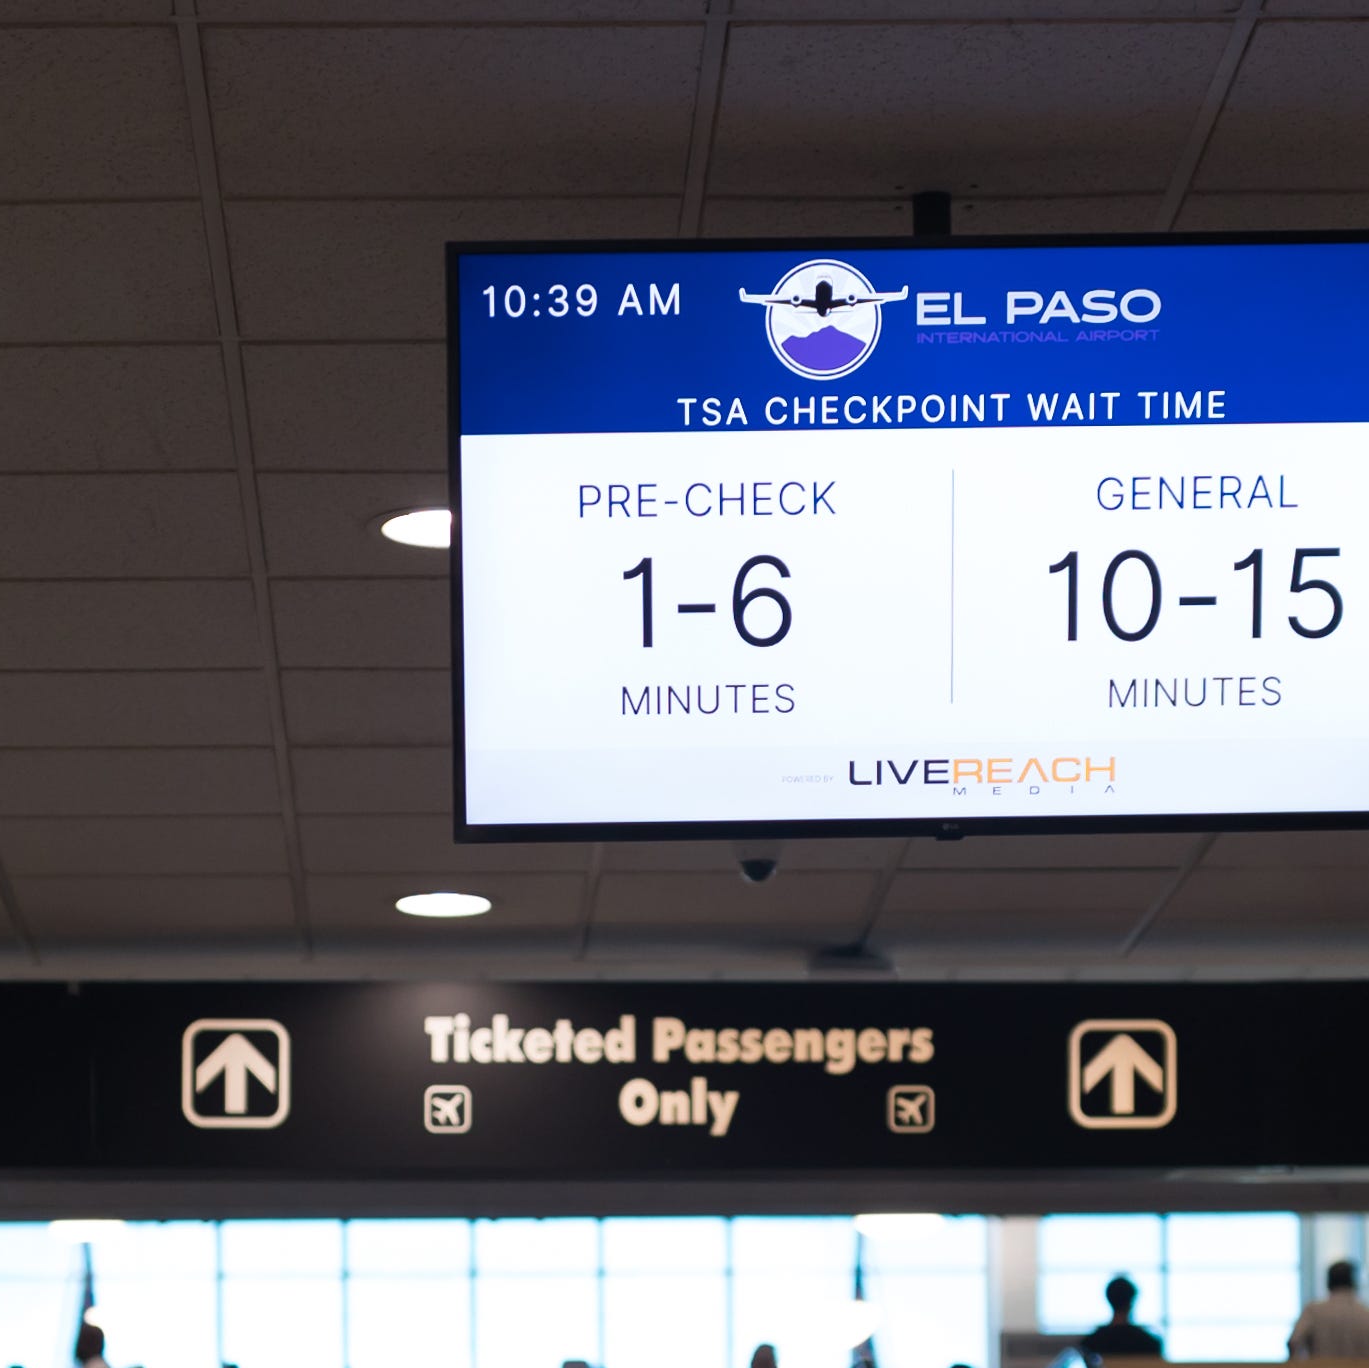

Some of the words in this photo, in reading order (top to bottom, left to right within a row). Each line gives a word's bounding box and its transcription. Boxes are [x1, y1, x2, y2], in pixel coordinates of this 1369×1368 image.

[482, 283, 599, 318] 10:39
[617, 282, 681, 316] AM
[916, 291, 987, 326] EL
[1006, 288, 1162, 325] PASO
[916, 330, 1069, 344] INTERNATIONAL
[1074, 328, 1161, 343] AIRPORT
[677, 396, 749, 427] TSA
[764, 393, 1012, 426] CHECKPOINT
[1026, 392, 1124, 422] WAIT
[1137, 390, 1227, 420] TIME
[578, 480, 837, 519] PRE-CHECK
[1096, 474, 1299, 512] GENERAL
[621, 554, 794, 649] 1-6
[1047, 547, 1345, 643] 10-15
[620, 682, 796, 716] MINUTES
[1107, 676, 1283, 709] MINUTES
[423, 1013, 636, 1065] Ticketed
[652, 1015, 936, 1075] Passengers
[617, 1076, 740, 1137] Only
